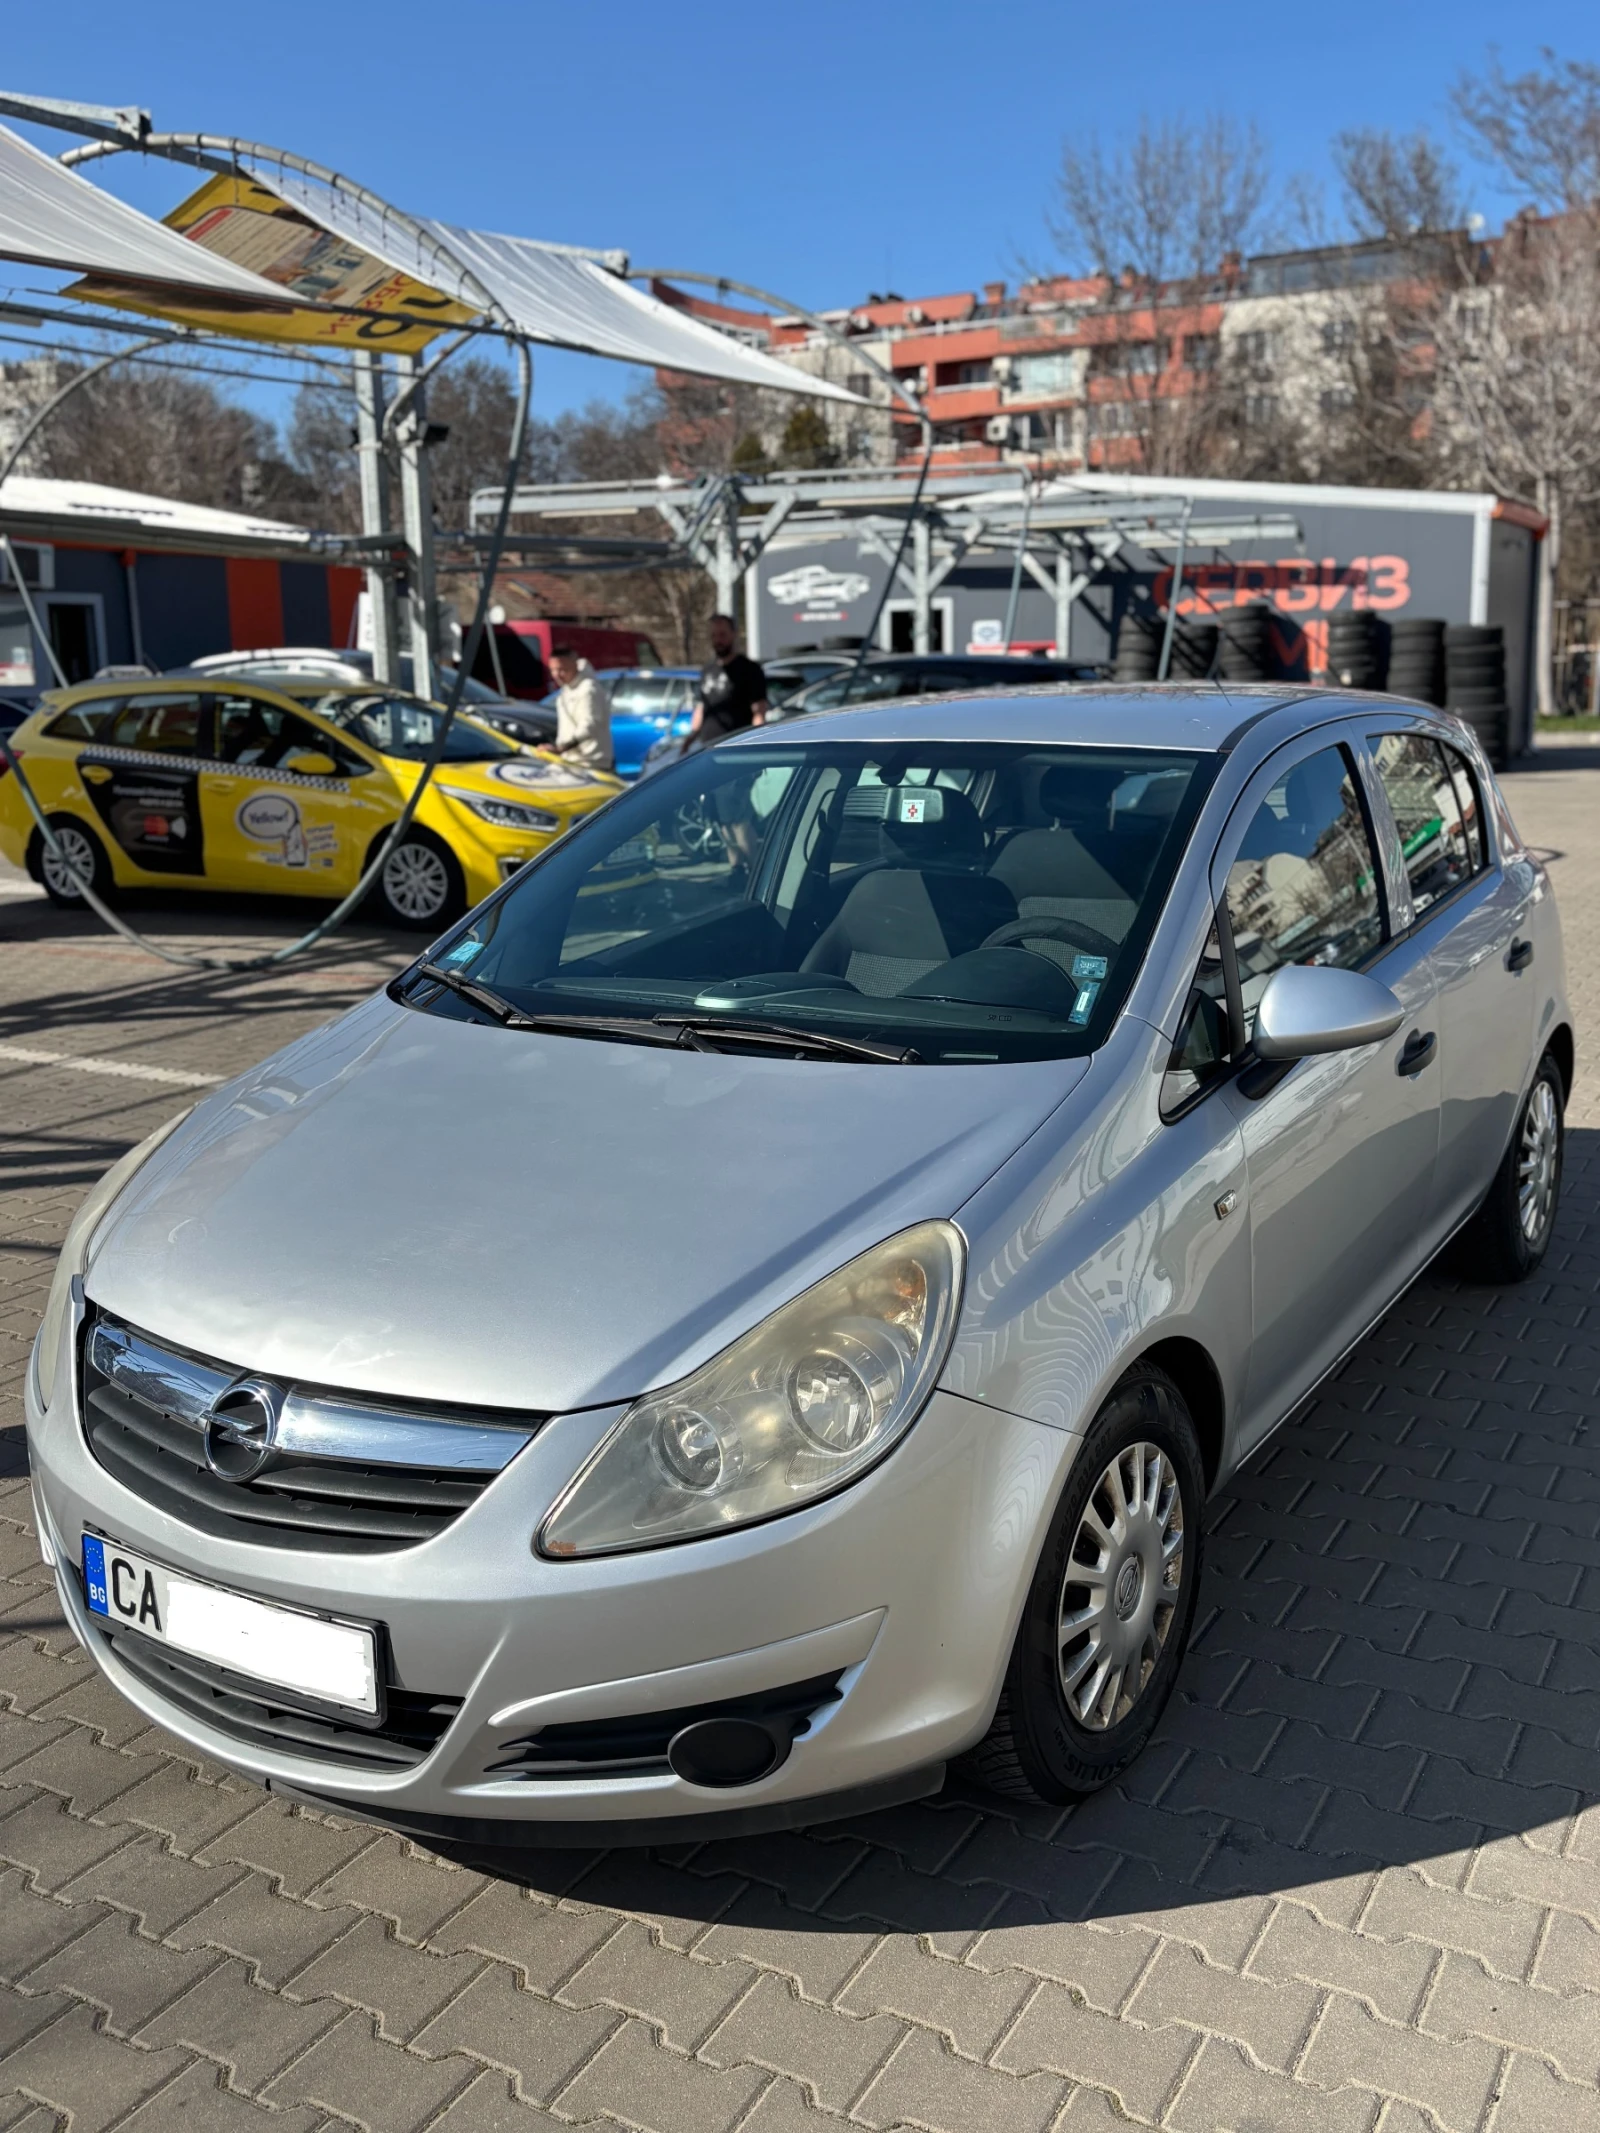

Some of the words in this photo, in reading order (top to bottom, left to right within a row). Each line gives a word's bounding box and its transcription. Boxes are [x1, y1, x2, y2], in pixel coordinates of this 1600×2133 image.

[1153, 555, 1411, 615] СЕРВИЗ
[89, 1582, 106, 1604] BG
[111, 1557, 163, 1633] CA
[1063, 1754, 1127, 1781] SOLUS
